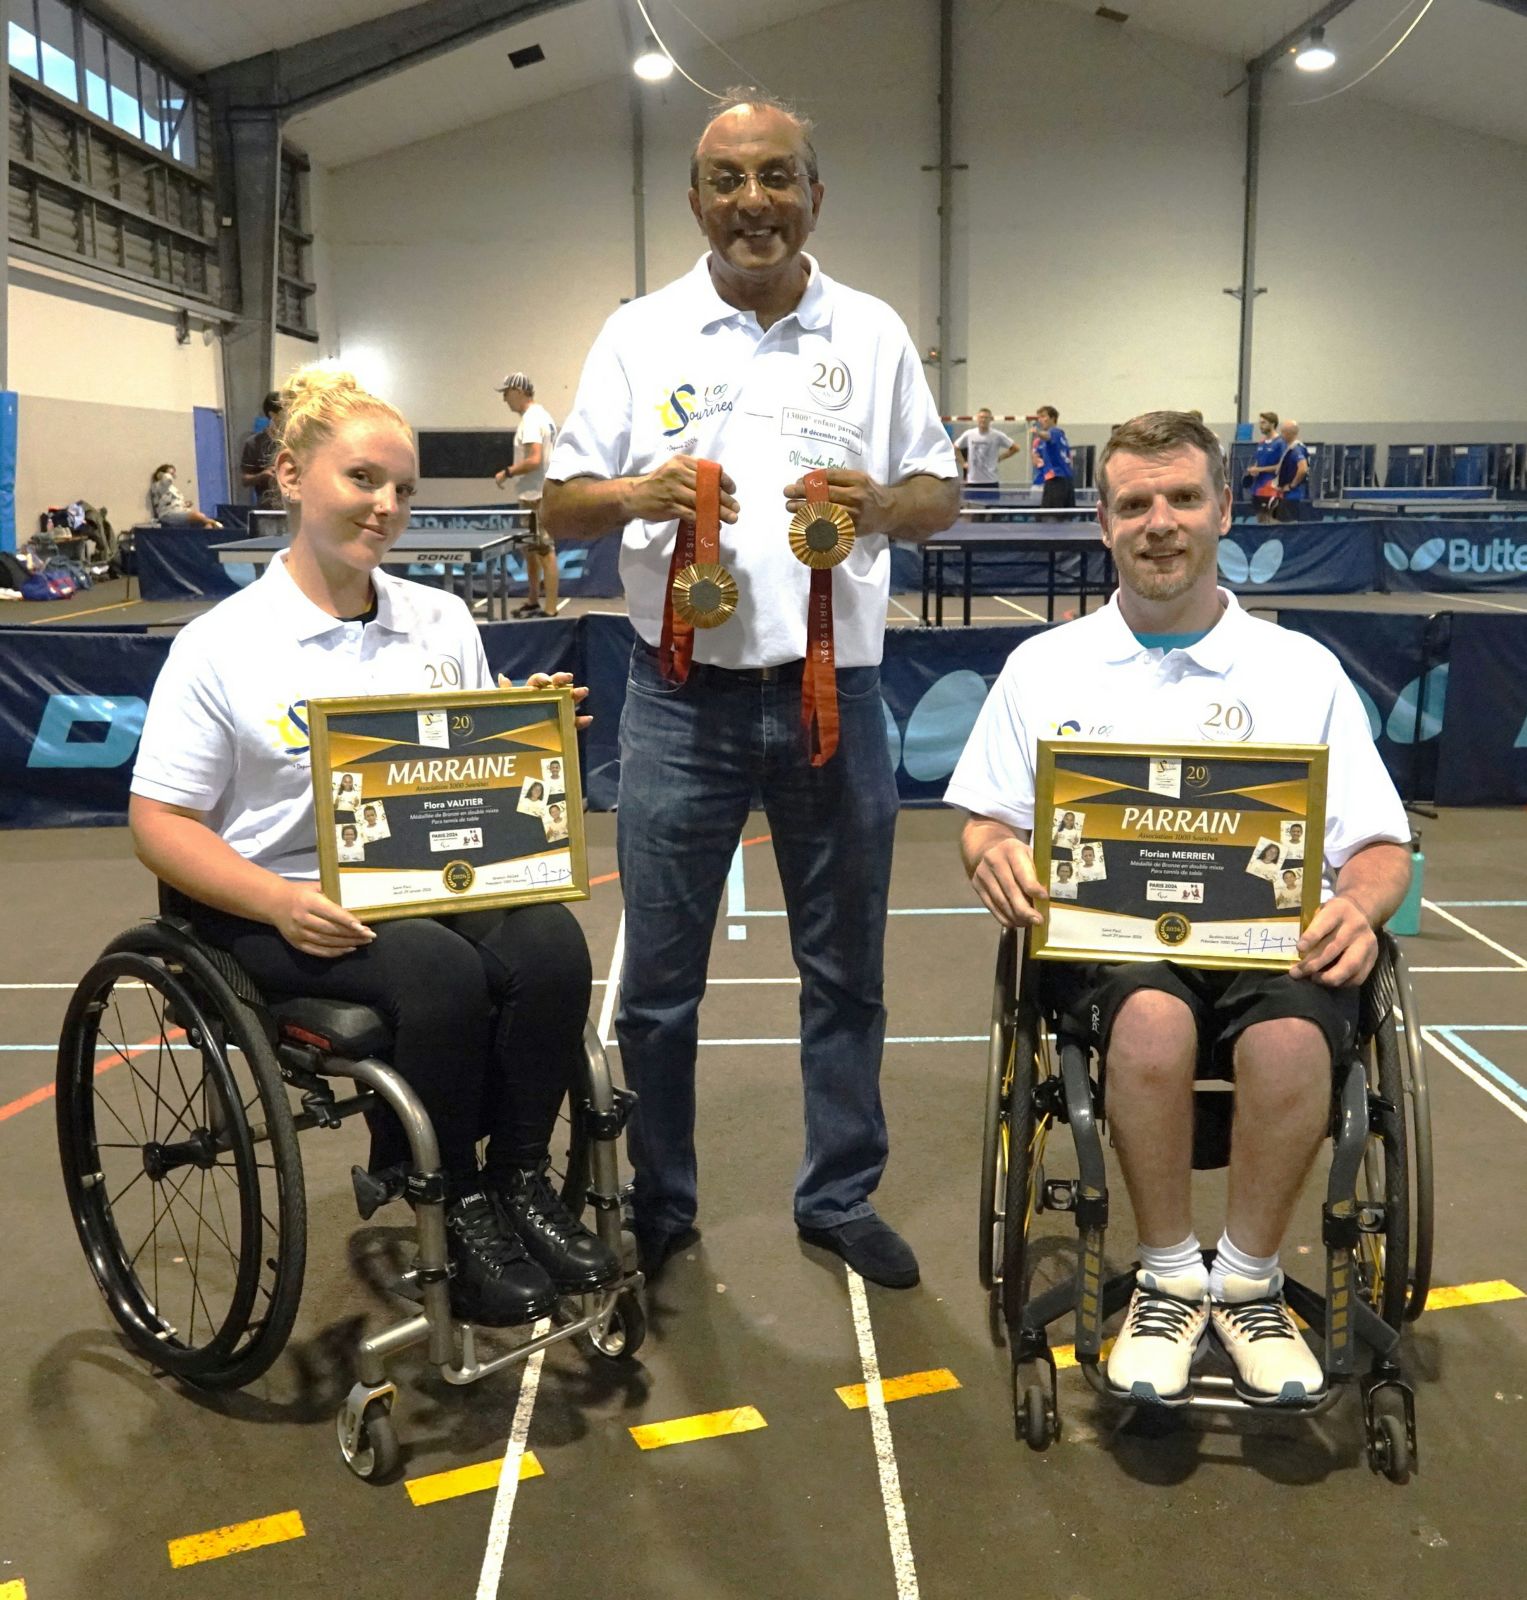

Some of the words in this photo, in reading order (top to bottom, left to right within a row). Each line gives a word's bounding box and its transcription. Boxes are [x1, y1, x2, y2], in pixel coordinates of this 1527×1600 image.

[811, 362, 846, 394] 20
[424, 661, 459, 689] 20
[452, 715, 470, 730] 20
[1203, 702, 1244, 730] 20
[386, 755, 517, 786] MARRAINE
[1186, 765, 1206, 780] 20
[424, 801, 446, 810] Flora
[447, 797, 484, 808] VAUTIER
[1121, 807, 1241, 835] PARRAIN
[1139, 849, 1170, 859] Florian
[1171, 851, 1215, 861] MERRIEN
